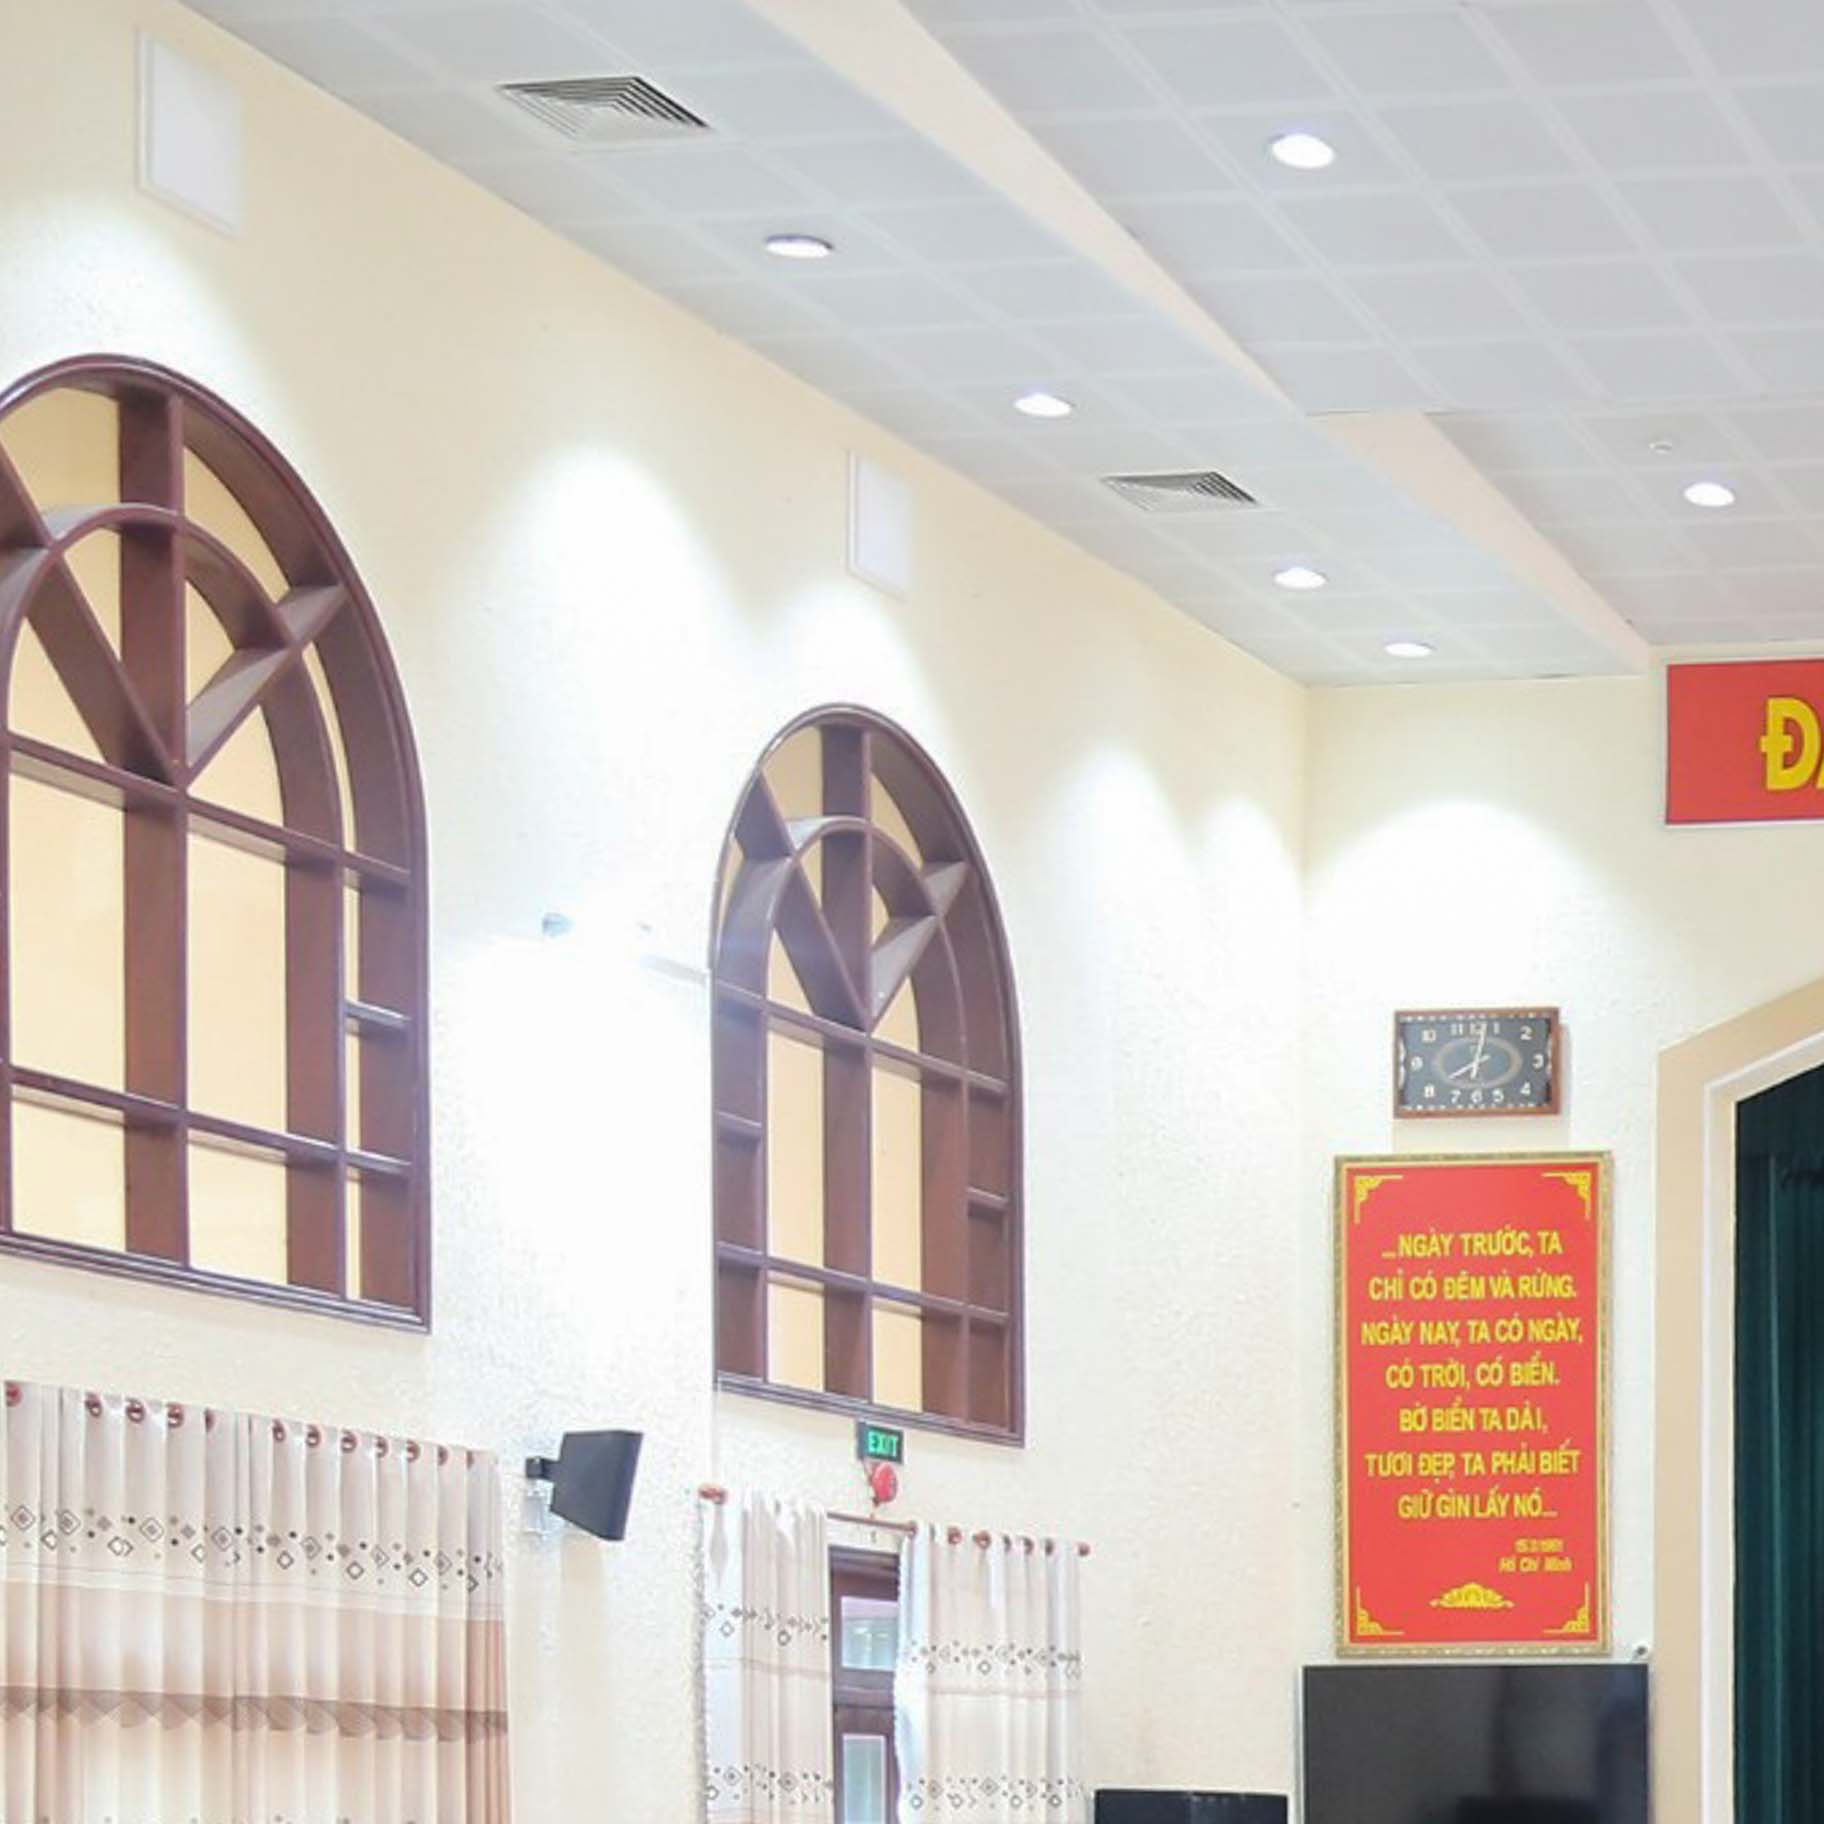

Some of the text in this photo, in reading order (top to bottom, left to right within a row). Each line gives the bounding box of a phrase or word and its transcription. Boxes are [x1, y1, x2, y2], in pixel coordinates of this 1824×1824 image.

[1537, 1229, 1563, 1255] TA
[1368, 1269, 1403, 1300] CHỈ
[1408, 1271, 1437, 1300] CÓ
[1443, 1271, 1485, 1300] ĐÊM
[1489, 1270, 1515, 1299] VÀ
[1361, 1315, 1414, 1345] NGÀY
[1420, 1321, 1460, 1347] NAY,
[1467, 1321, 1490, 1345] TA
[1495, 1313, 1523, 1343] CÓ
[1385, 1358, 1414, 1388] CÓ
[1475, 1355, 1504, 1387] CÓ
[1399, 1402, 1428, 1432] BỜ
[1432, 1396, 1475, 1432] BIỂN
[1480, 1407, 1503, 1431] TA
[1364, 1450, 1412, 1477] TƯƠI
[1461, 1452, 1486, 1476] TA
[1492, 1443, 1536, 1475] PHẢI
[1540, 1439, 1581, 1474] BIẾT
[1398, 1490, 1433, 1519] GIỮ
[1436, 1487, 1471, 1519] GÌN
[1474, 1484, 1510, 1518] LẤY
